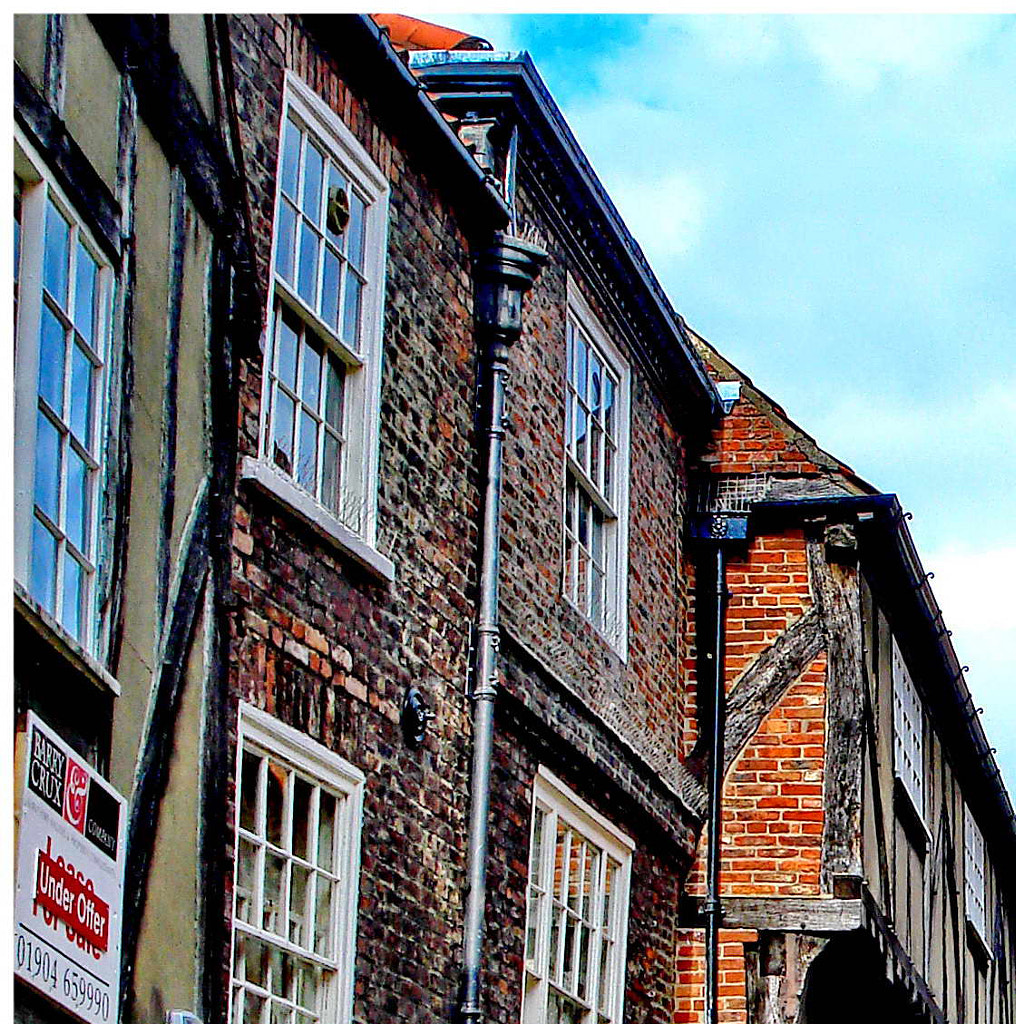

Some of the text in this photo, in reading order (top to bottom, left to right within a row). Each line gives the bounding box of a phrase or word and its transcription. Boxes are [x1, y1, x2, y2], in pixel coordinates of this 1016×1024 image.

[31, 760, 63, 808] CRUX
[34, 731, 66, 780] BARRY
[40, 861, 75, 914] Under
[77, 892, 106, 937] Offer
[16, 935, 110, 1022] 01904 659990
